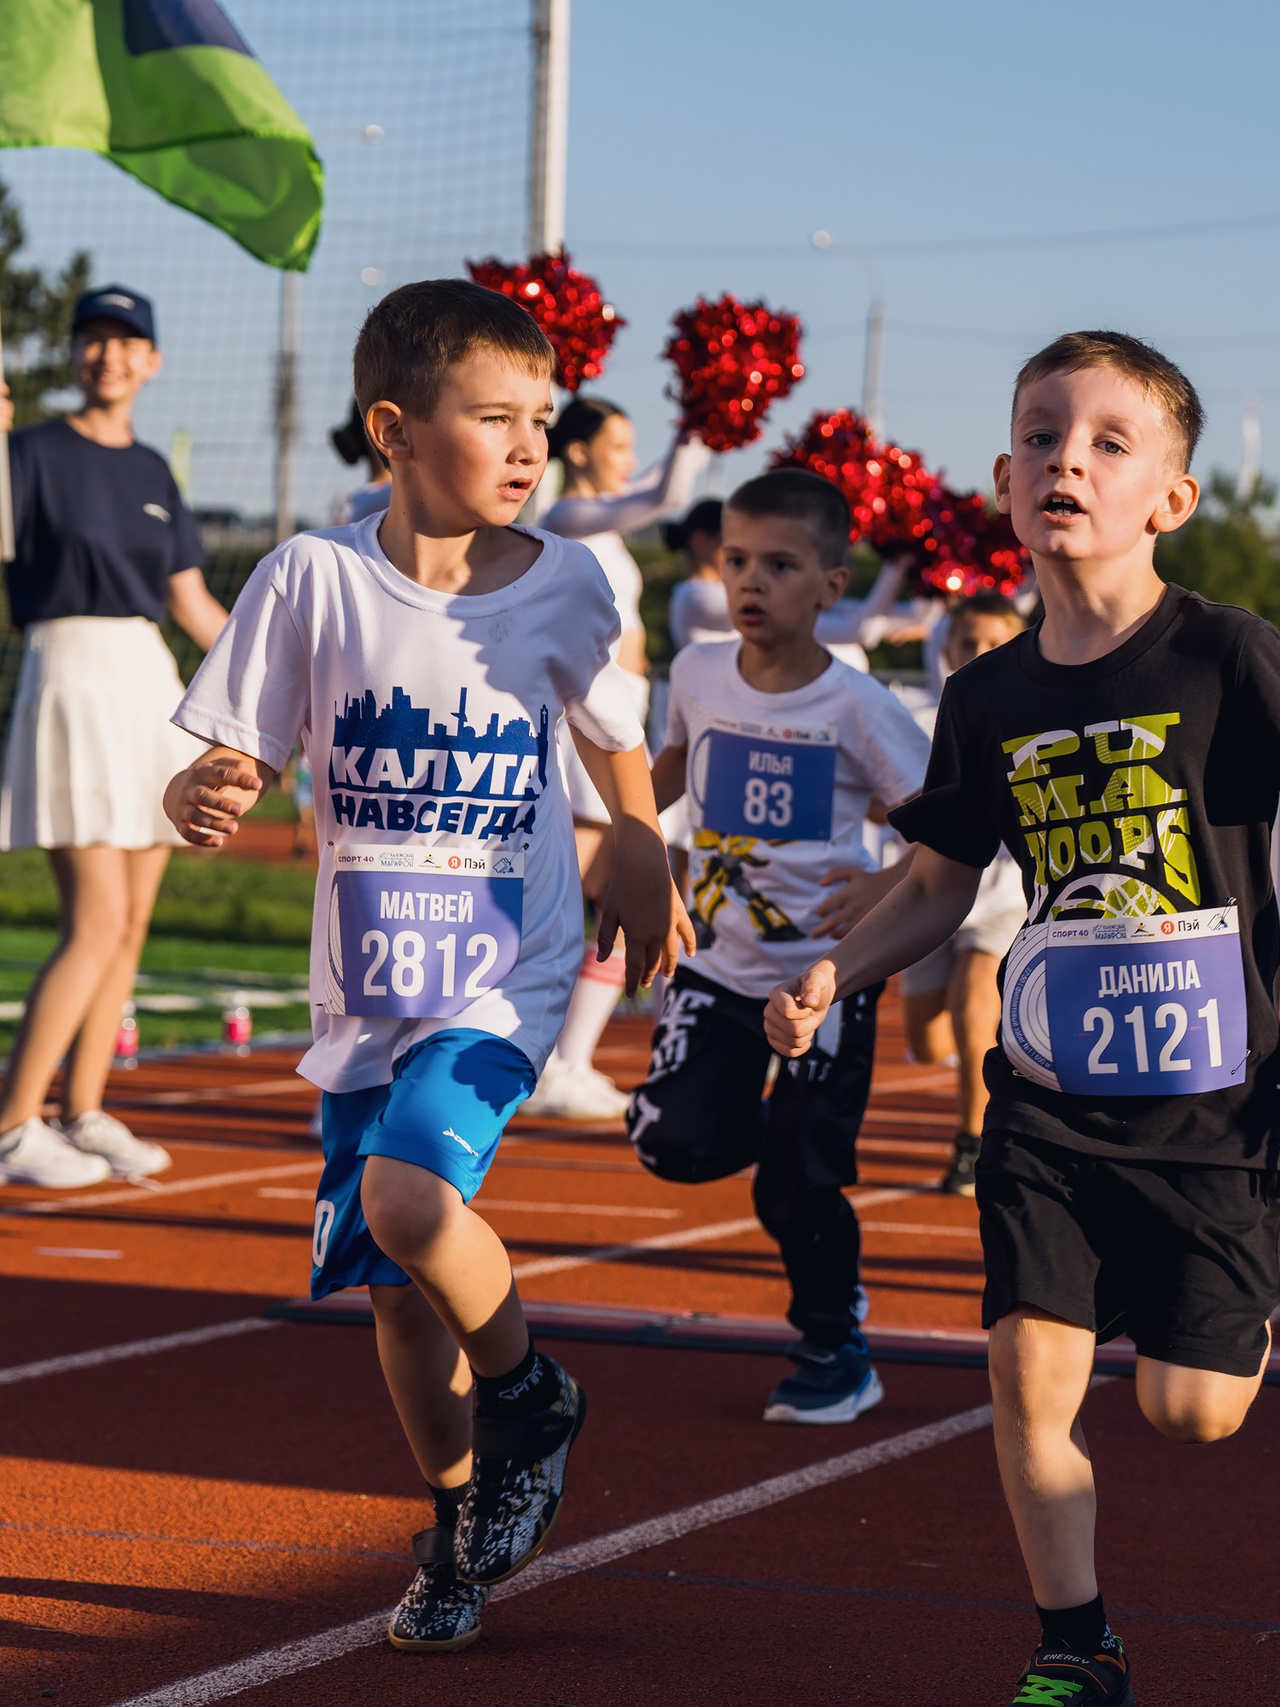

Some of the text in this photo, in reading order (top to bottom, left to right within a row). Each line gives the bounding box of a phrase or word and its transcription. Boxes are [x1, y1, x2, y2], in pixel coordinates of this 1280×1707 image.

[749, 750, 794, 776] ИЛЬЯ
[1001, 712, 1181, 783] PU
[332, 746, 543, 796] КАЛУГА
[743, 778, 794, 827] 83
[1011, 765, 1188, 827] MA
[331, 793, 537, 842] НАВСЕГДА
[338, 855, 362, 863] СПОРТ
[464, 857, 486, 870] Пэй
[380, 890, 474, 923] МАТВЕЙ
[1178, 918, 1200, 932] Пэй
[1052, 930, 1077, 938] СПОРТ
[1078, 929, 1089, 937] 40
[361, 930, 499, 998] 2812
[1098, 959, 1201, 999] ДАНИЛА
[1082, 998, 1223, 1075] 2121
[1042, 1653, 1090, 1665] ENERGY
